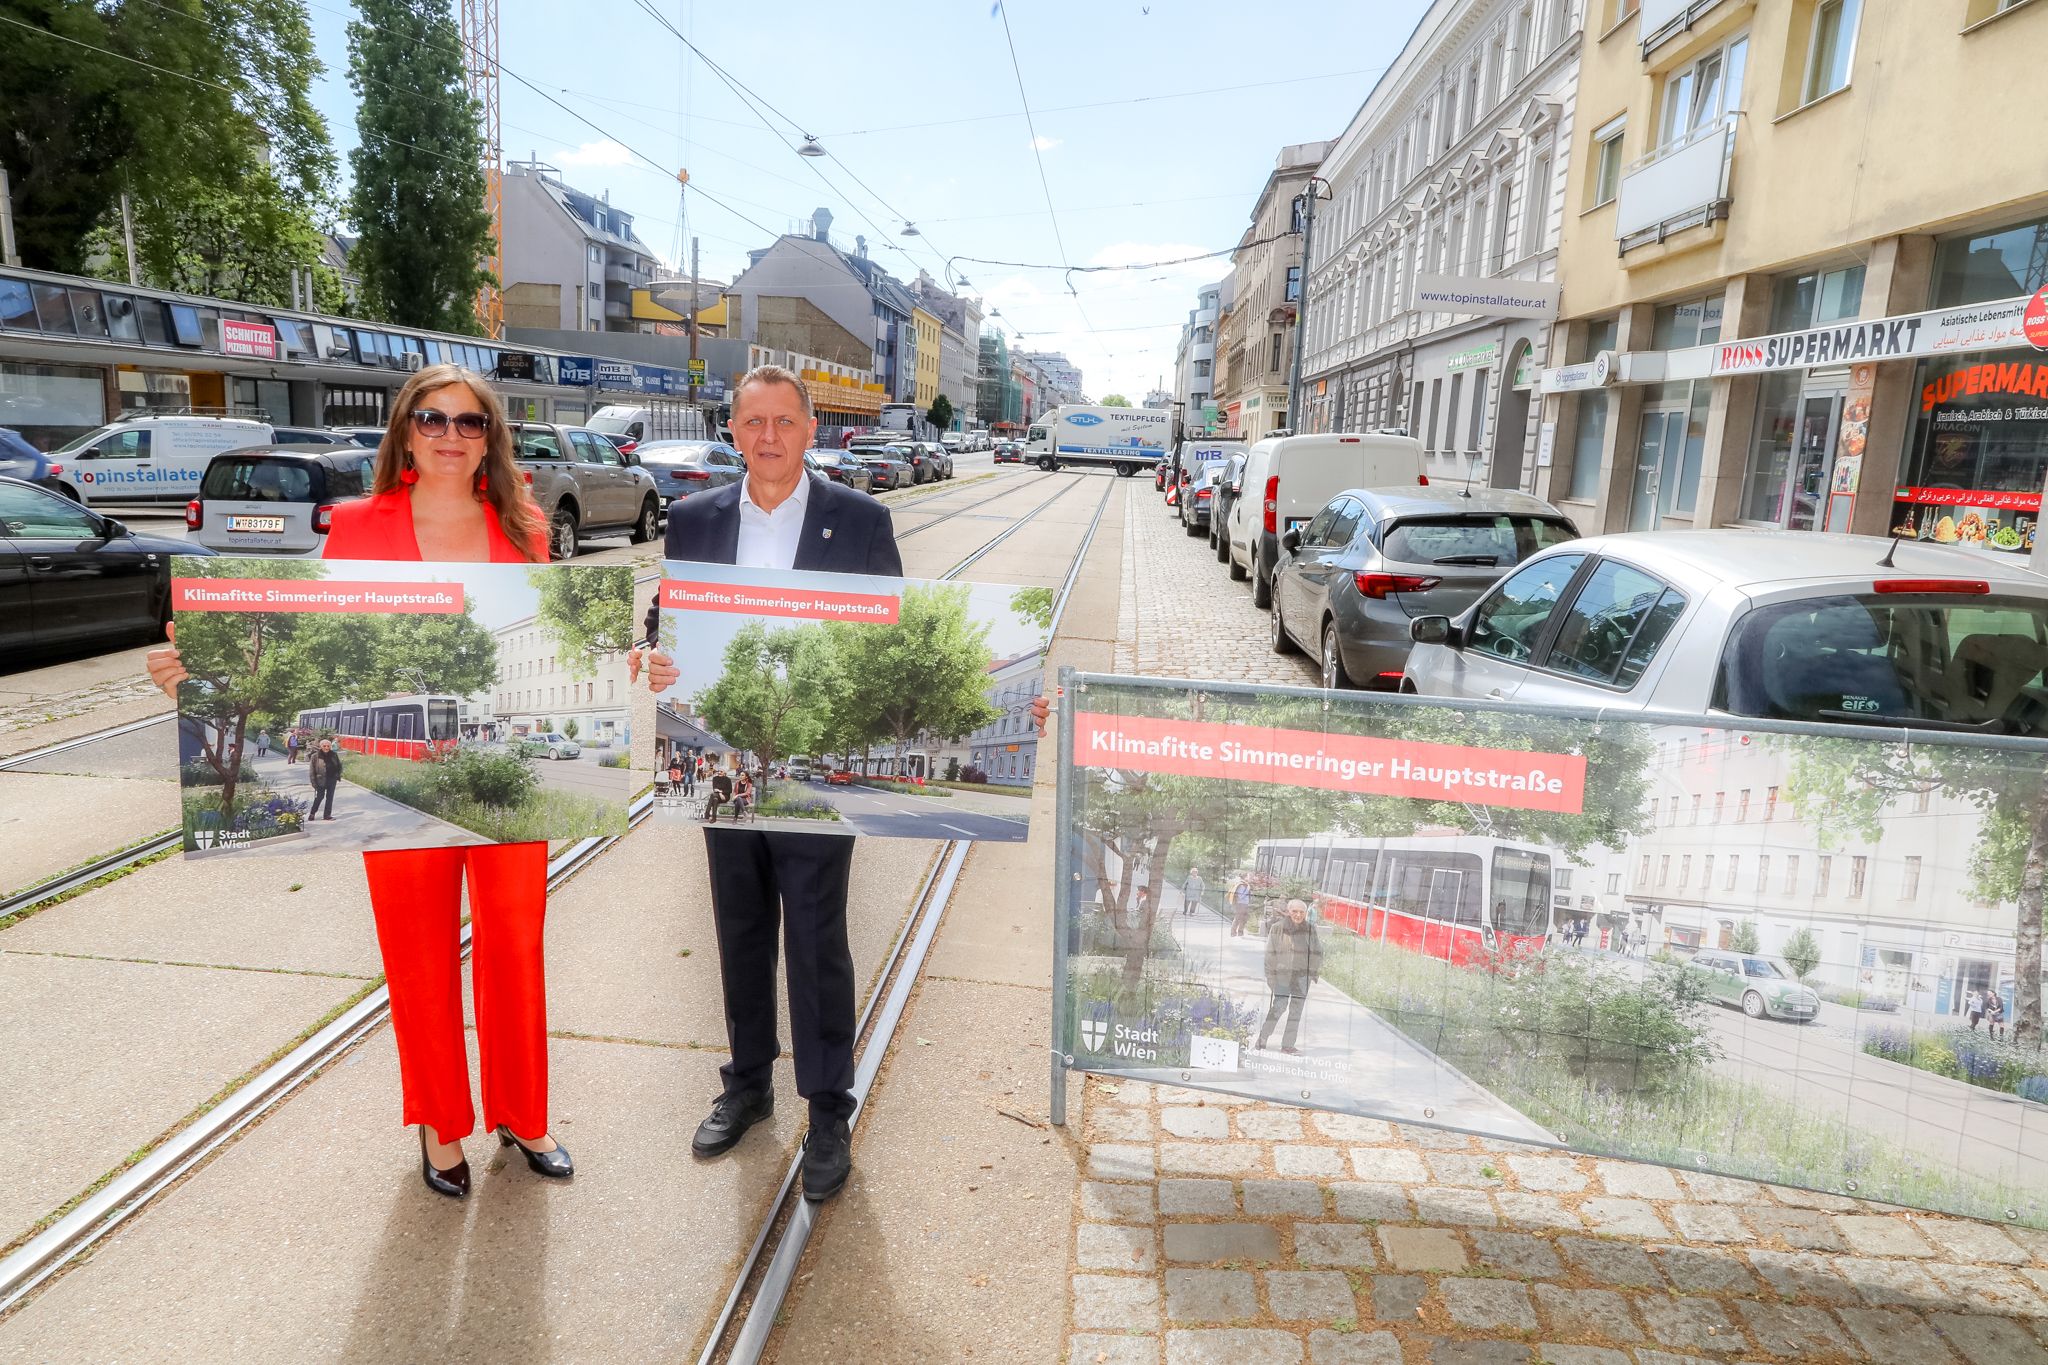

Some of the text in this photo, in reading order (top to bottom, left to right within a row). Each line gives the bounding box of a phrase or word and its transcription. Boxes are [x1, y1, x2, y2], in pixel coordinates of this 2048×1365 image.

[1421, 292, 1546, 309] www.topinstallateur.at
[1941, 311, 1977, 327] Asiatische
[2026, 316, 2046, 326] ROSS
[225, 326, 273, 345] SCHNITZEL
[226, 341, 273, 357] PIZZERIA PROFI
[1720, 318, 1921, 370] ROSS SUPERMARKT
[561, 368, 590, 380] MB
[600, 374, 631, 382] GLASEREI
[1110, 413, 1166, 423] TEXTILPFLEGE
[1937, 411, 1967, 423] Iranisch,
[1967, 409, 2002, 422] Arabisch
[2004, 408, 2012, 420] &
[1932, 422, 1981, 433] DRAGON
[1082, 447, 1140, 456] TEXTILLEASING
[1196, 450, 1222, 460] MB
[74, 468, 203, 485] topinstallate
[229, 537, 281, 545] topinstallateur.at
[184, 589, 453, 606] Klimafitte Simmeringer Hauptstraße
[669, 589, 889, 616] Klimafitte Simmeringer Hauptstraße
[1091, 730, 1563, 795] Klimafitte Simmeringer Hauptstraße
[681, 800, 706, 810] Stadt
[219, 829, 251, 839] Stadt
[219, 840, 251, 849] Wien
[1114, 1024, 1160, 1044] Stadt
[1114, 1040, 1157, 1061] Wien
[1244, 1060, 1317, 1079] Europäischen
[1312, 1058, 1332, 1068] von
[1334, 1062, 1353, 1073] der
